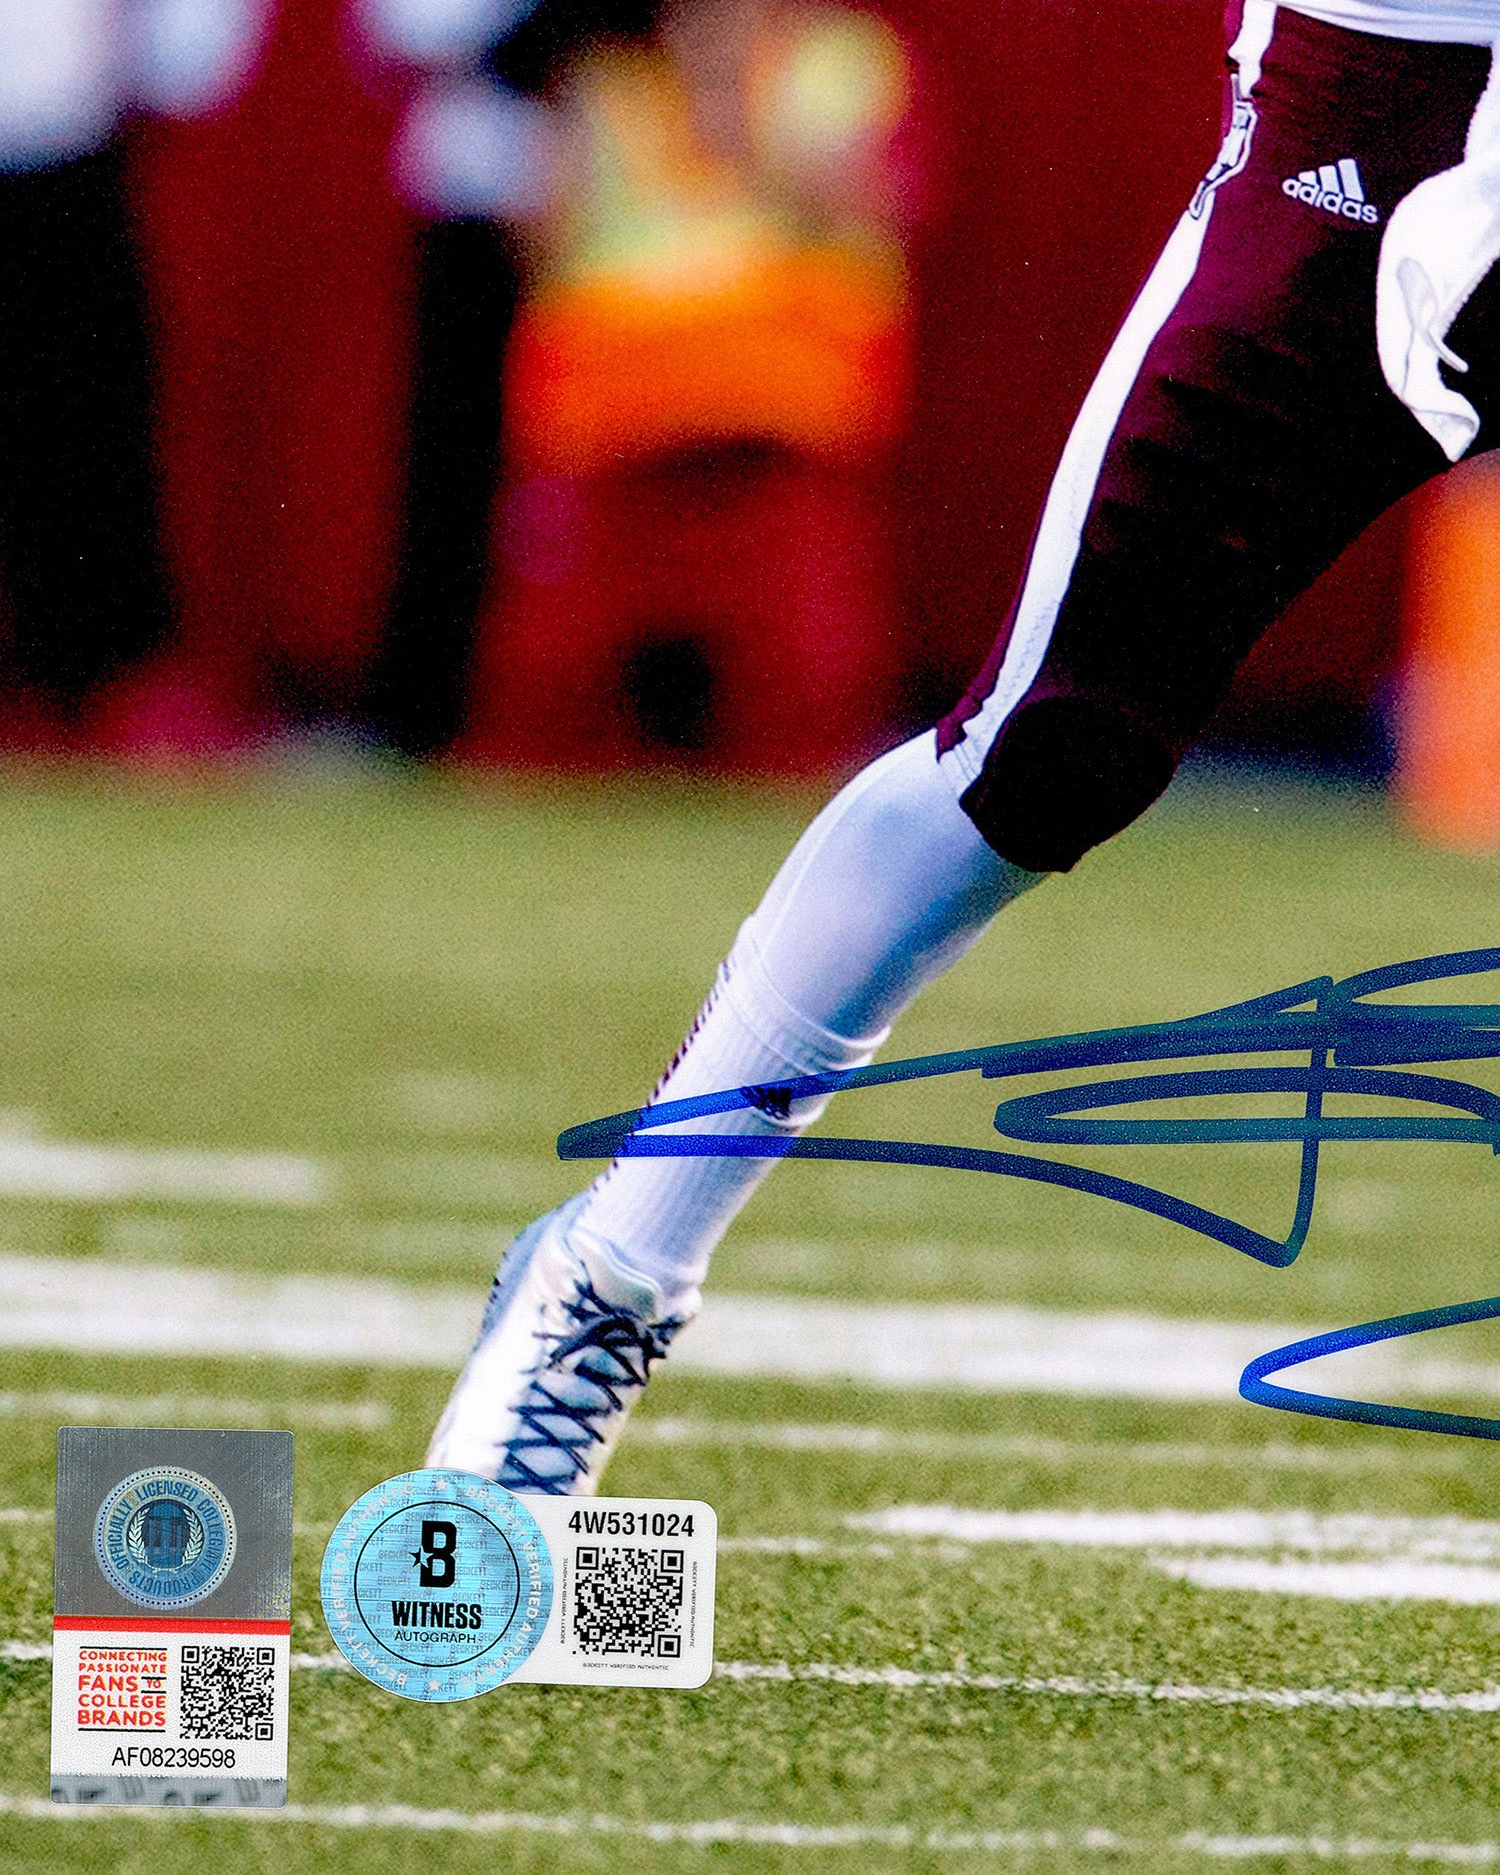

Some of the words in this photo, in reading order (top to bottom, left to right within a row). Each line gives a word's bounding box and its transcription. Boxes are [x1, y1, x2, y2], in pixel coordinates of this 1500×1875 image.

[1282, 178, 1379, 224] adidas
[134, 1480, 199, 1502] LICENSED
[343, 1482, 416, 1553] AUTHENTIC
[568, 1511, 695, 1537] 4W531024
[108, 1498, 133, 1570] OFFICIALLY
[197, 1499, 226, 1576] COLLEGIATE
[465, 1486, 527, 1537] BECKETT
[523, 1539, 542, 1619] VERIFIED
[128, 1570, 201, 1596] PRODUCTS
[331, 1553, 349, 1631] VERIFIED
[391, 1600, 482, 1630] WITNESS
[394, 1631, 476, 1644] AUTOGRAPH
[78, 1663, 167, 1673] PASSIONATE
[79, 1650, 167, 1662] CONNECTING
[346, 1634, 407, 1686] BECKETT
[78, 1675, 139, 1692] FANS
[147, 1679, 162, 1689] TO
[78, 1694, 166, 1708] COLLEGE
[77, 1709, 166, 1727] BRANDS
[111, 1746, 236, 1768] AF08239598
